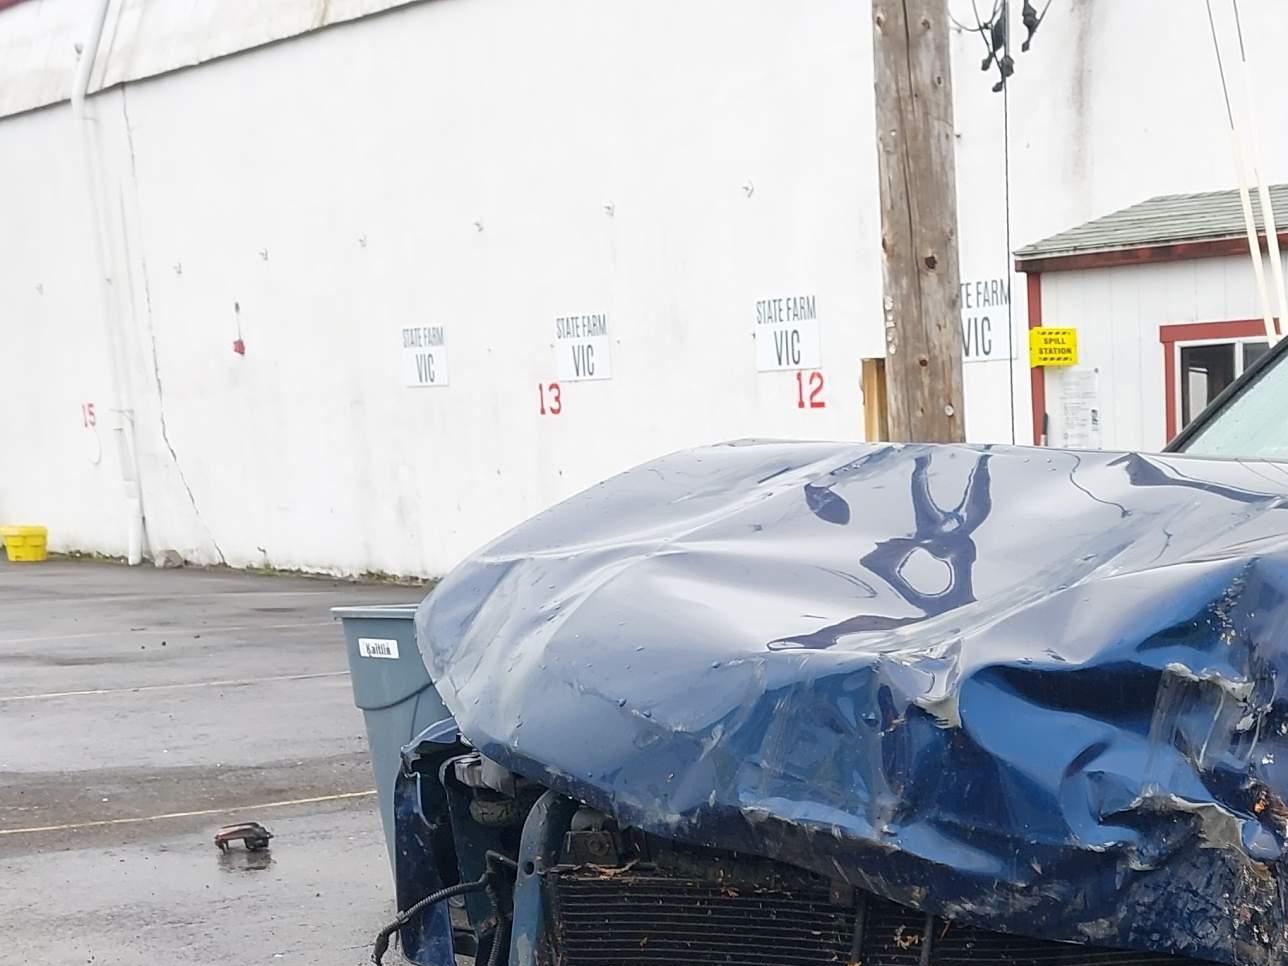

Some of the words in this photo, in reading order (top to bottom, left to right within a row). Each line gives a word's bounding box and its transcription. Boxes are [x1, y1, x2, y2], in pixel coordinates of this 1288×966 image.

[756, 299, 783, 324] STATE
[786, 295, 816, 321] FARM
[402, 327, 422, 348] STATE
[423, 326, 445, 346] FARM
[556, 316, 580, 339] STATE
[582, 313, 608, 337] FARM
[961, 316, 992, 357] VIC
[773, 329, 800, 366] VIC
[1039, 347, 1072, 355] STATION
[1043, 337, 1066, 345] SPILL
[416, 353, 435, 383] VIC
[571, 344, 594, 377] VIC
[539, 383, 561, 415] 13
[797, 372, 825, 408] 12
[81, 402, 96, 428] 15
